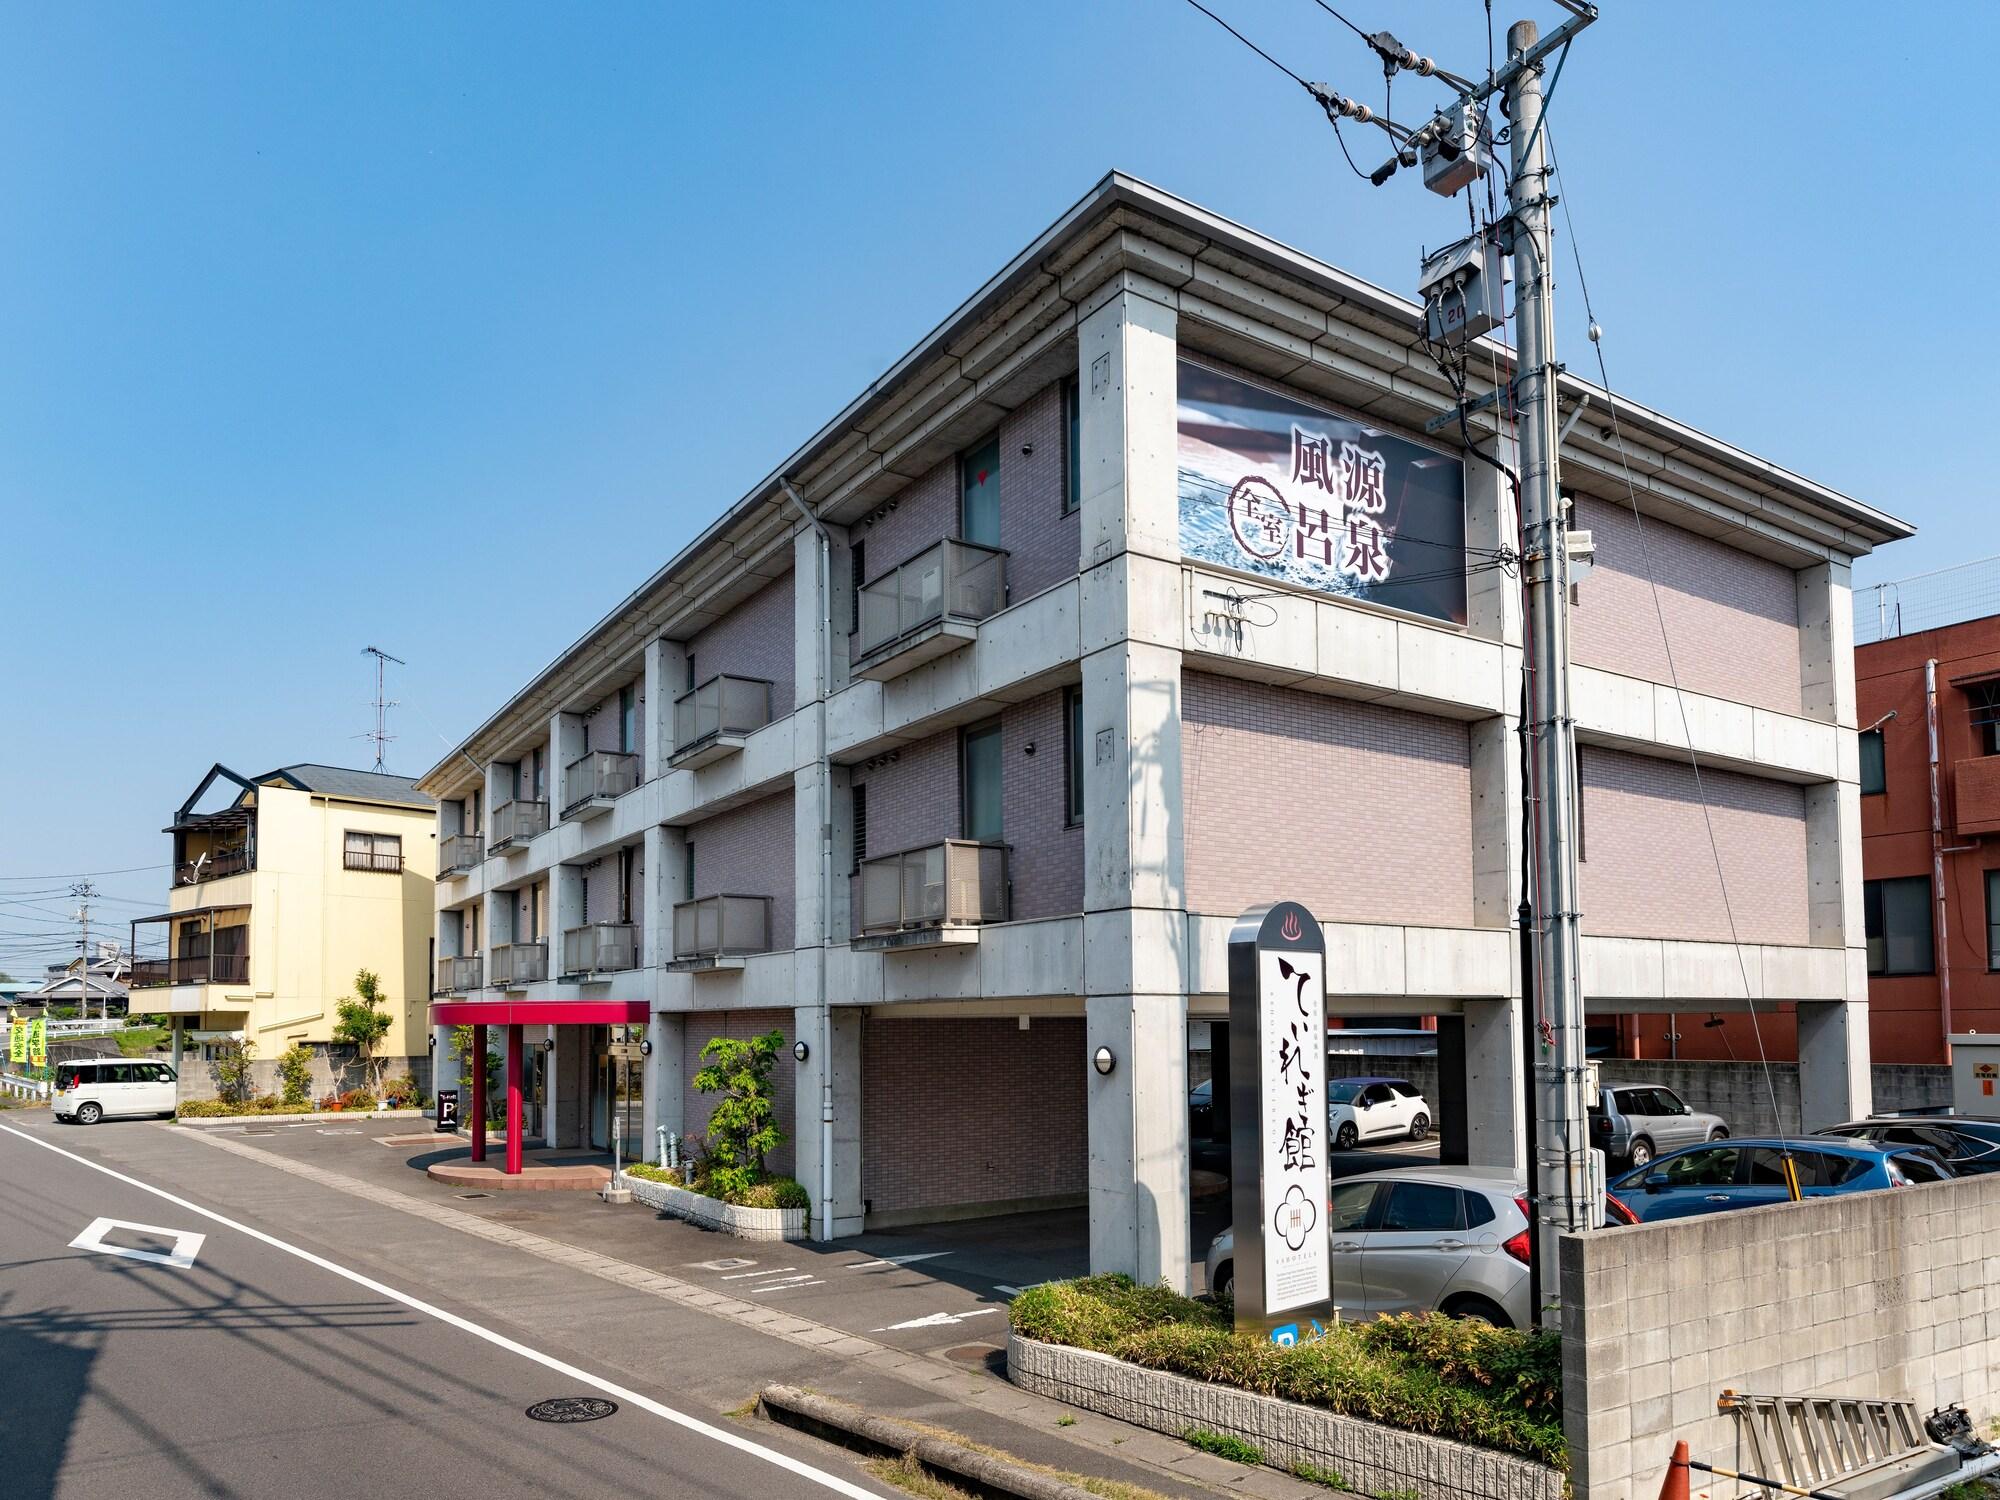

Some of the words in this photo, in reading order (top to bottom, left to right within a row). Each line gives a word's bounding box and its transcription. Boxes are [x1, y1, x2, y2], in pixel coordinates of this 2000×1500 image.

[1239, 487, 1283, 546] 全室
[1292, 427, 1334, 566] 風呂
[1343, 446, 1385, 576] 源泉
[443, 1102, 454, 1118] P
[1278, 956, 1316, 1172] ていれぎ館
